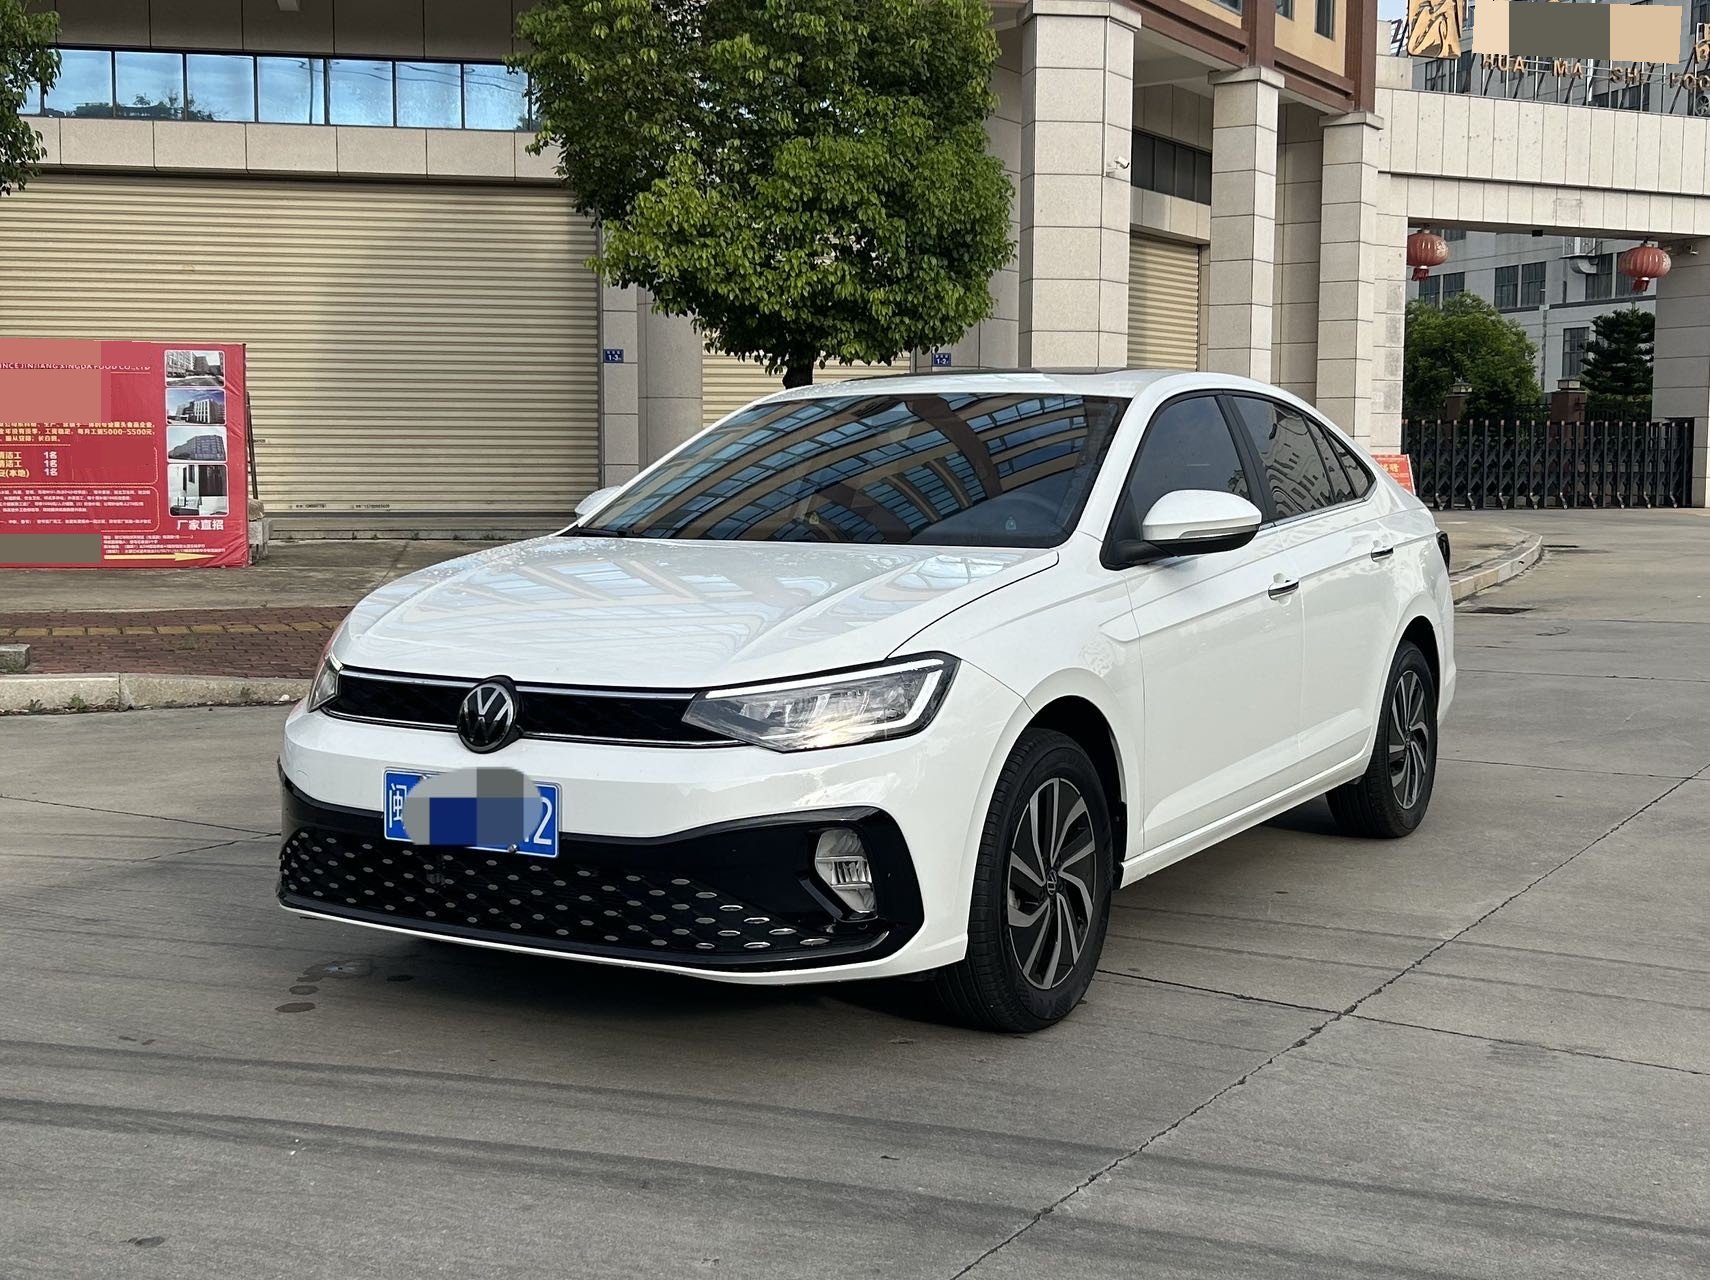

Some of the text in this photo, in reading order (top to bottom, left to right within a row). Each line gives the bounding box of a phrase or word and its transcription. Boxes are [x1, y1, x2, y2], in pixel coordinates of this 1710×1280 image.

[1553, 59, 1584, 79] MA
[43, 451, 57, 459] 1名
[43, 459, 58, 468] 1名
[43, 467, 58, 476] 1名
[176, 519, 224, 531] 厂家直招
